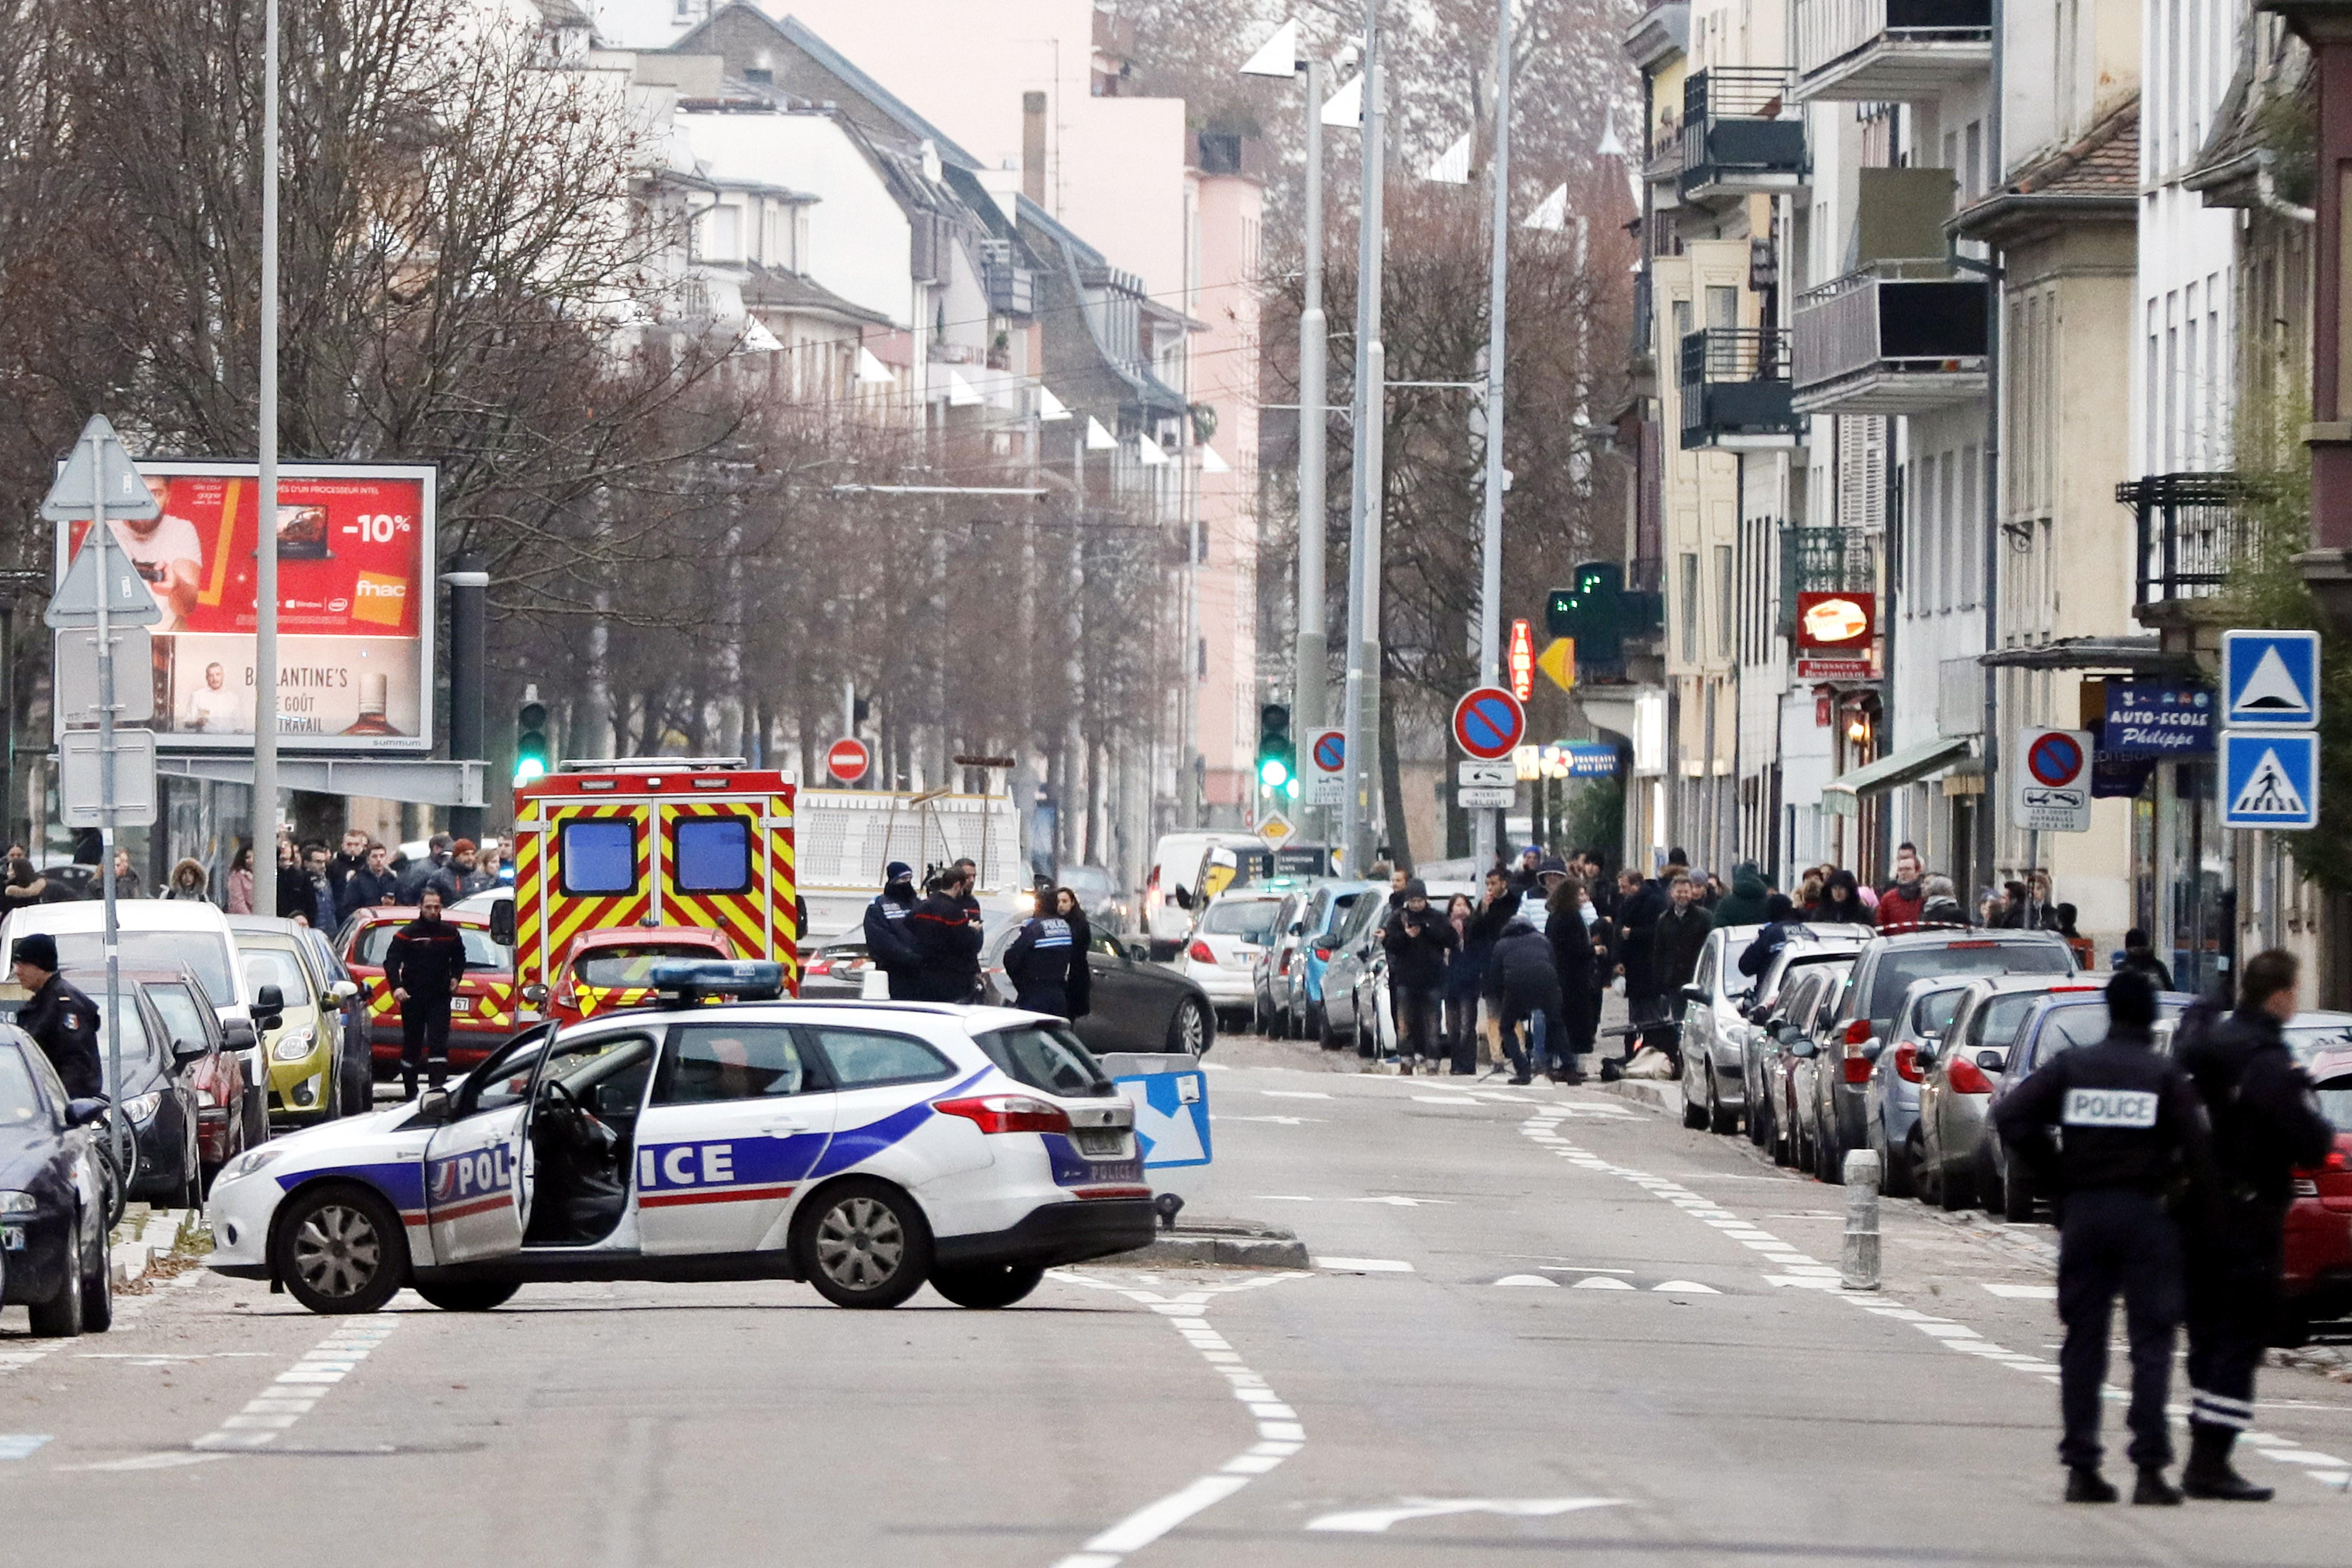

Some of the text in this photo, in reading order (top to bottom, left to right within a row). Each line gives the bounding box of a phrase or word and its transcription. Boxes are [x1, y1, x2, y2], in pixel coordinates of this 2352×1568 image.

[343, 514, 411, 542] -10%
[356, 580, 406, 597] fnac
[1513, 624, 1531, 701] TABAC
[285, 693, 315, 711] GOÛT
[2110, 711, 2208, 726] AUTO-ECOLE
[2122, 728, 2194, 748] Philippe
[455, 999, 467, 1010] 67
[2075, 1095, 2152, 1119] POLICE
[459, 1150, 509, 1194] POL
[1092, 1165, 1130, 1180] POLICE
